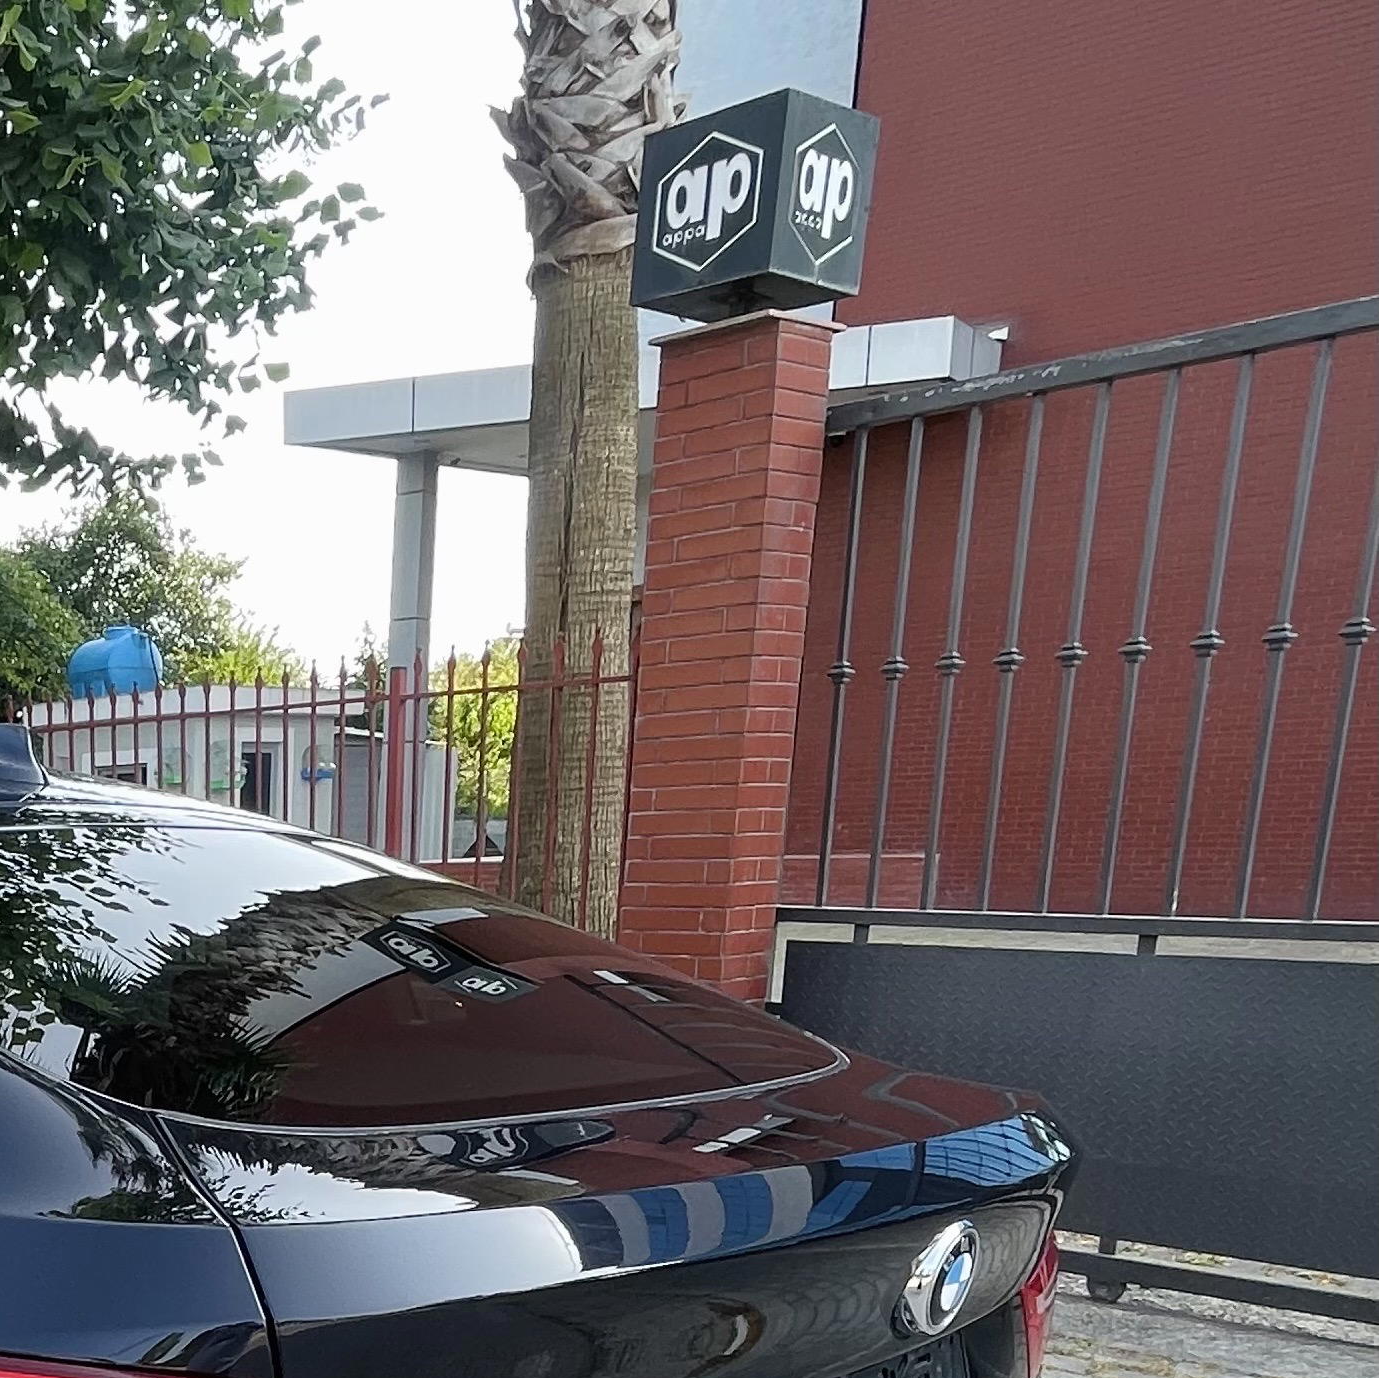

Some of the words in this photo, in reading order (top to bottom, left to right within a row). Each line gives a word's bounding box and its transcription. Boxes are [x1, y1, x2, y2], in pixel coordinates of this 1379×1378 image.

[662, 225, 706, 249] appa
[666, 152, 752, 241] ap
[799, 148, 854, 240] ap
